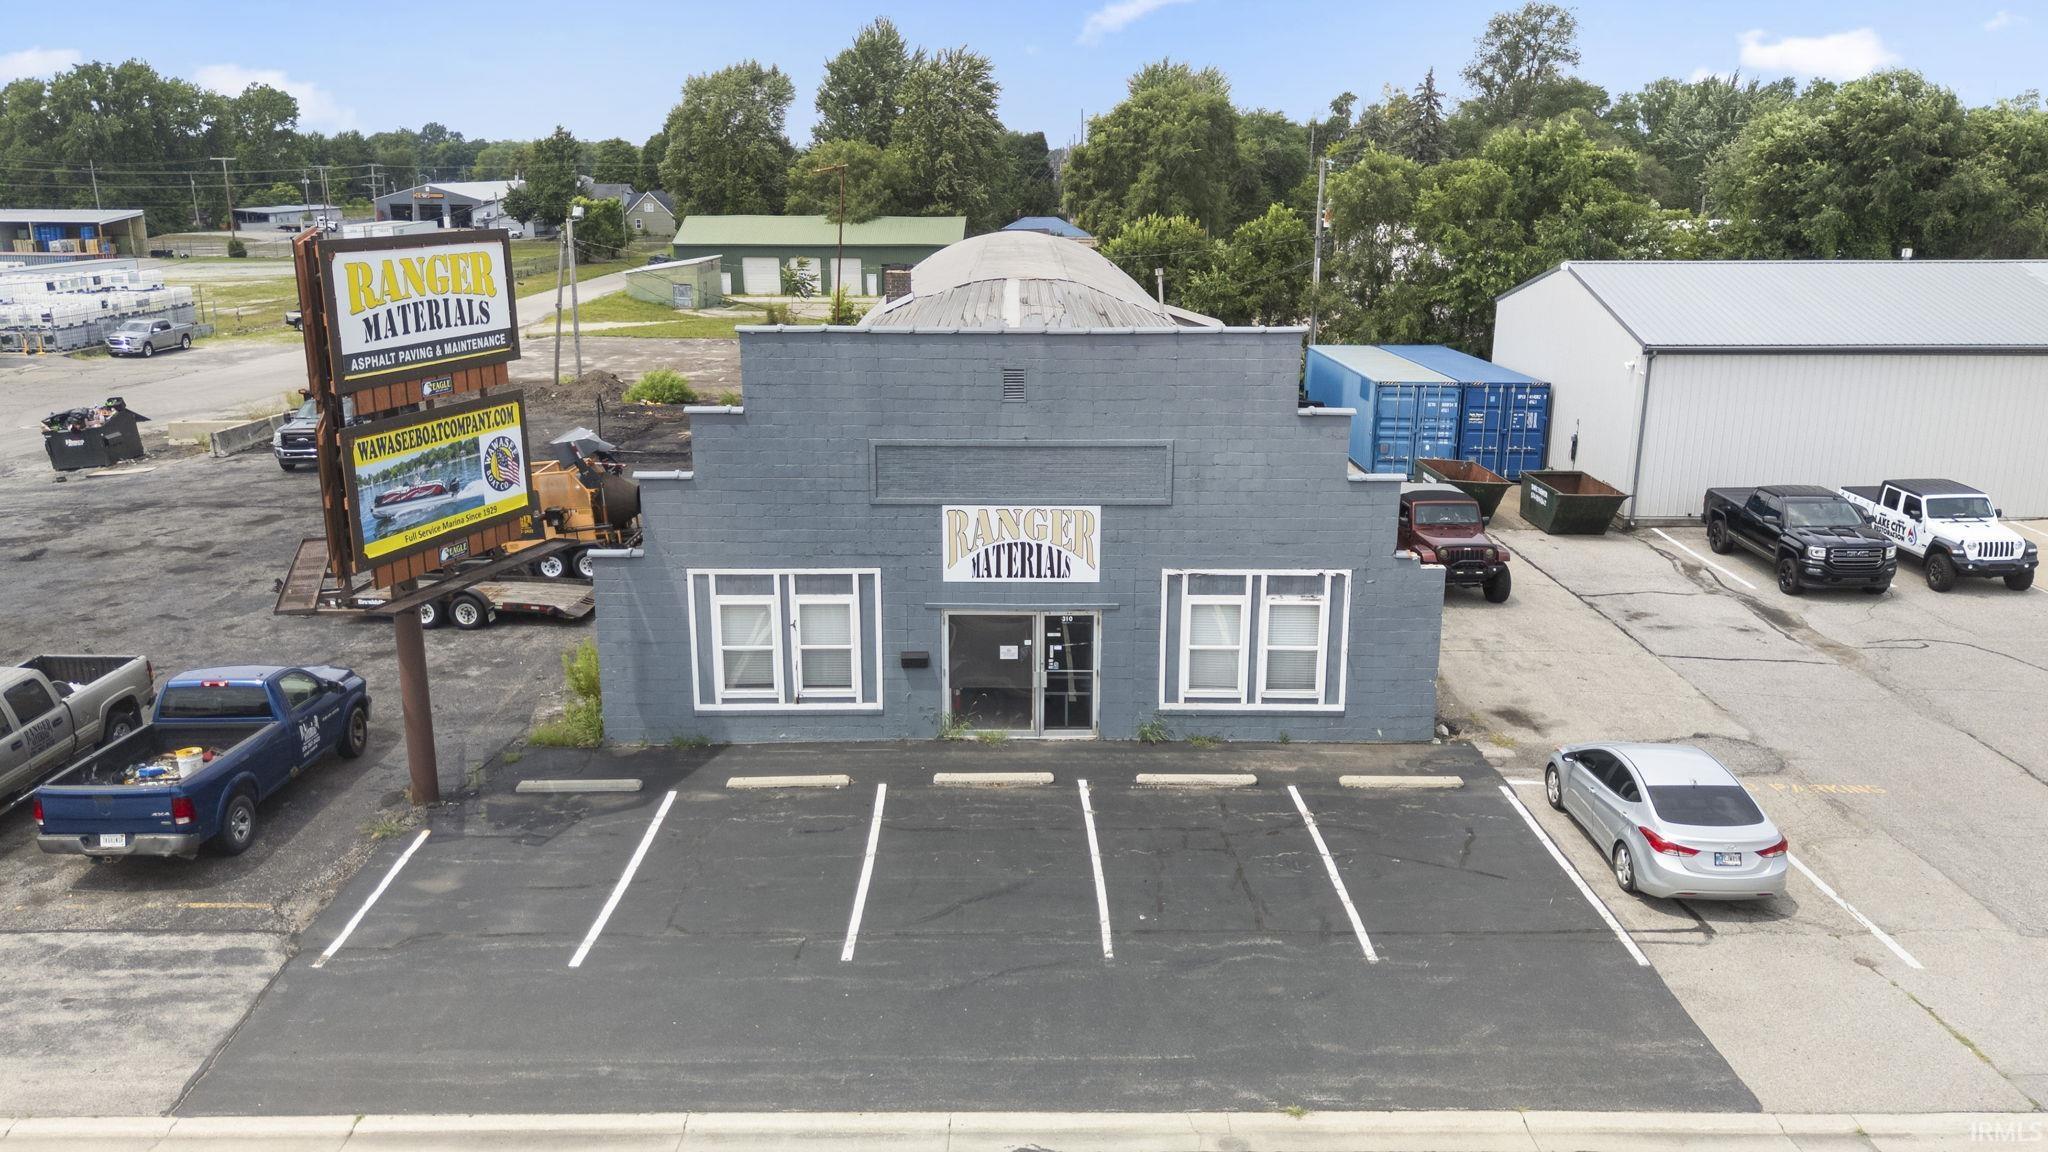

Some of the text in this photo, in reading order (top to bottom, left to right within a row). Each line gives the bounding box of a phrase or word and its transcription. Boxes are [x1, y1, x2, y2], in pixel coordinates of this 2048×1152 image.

[344, 251, 497, 315] RANGER
[362, 298, 491, 344] MATERIALS
[351, 333, 506, 371] ASPHALT PAVING & MAINTENANCE
[432, 379, 451, 391] EAGLE
[357, 405, 515, 462] WAWASEEBOATCOMPANY.COM
[486, 470, 500, 489] BOAT
[404, 505, 498, 543] Full Service Marina Since 1929
[946, 508, 1096, 571] RANGER
[1874, 515, 1907, 536] LAKE CITY
[450, 542, 467, 556] EAGLE
[971, 541, 1071, 579] MATERIALS
